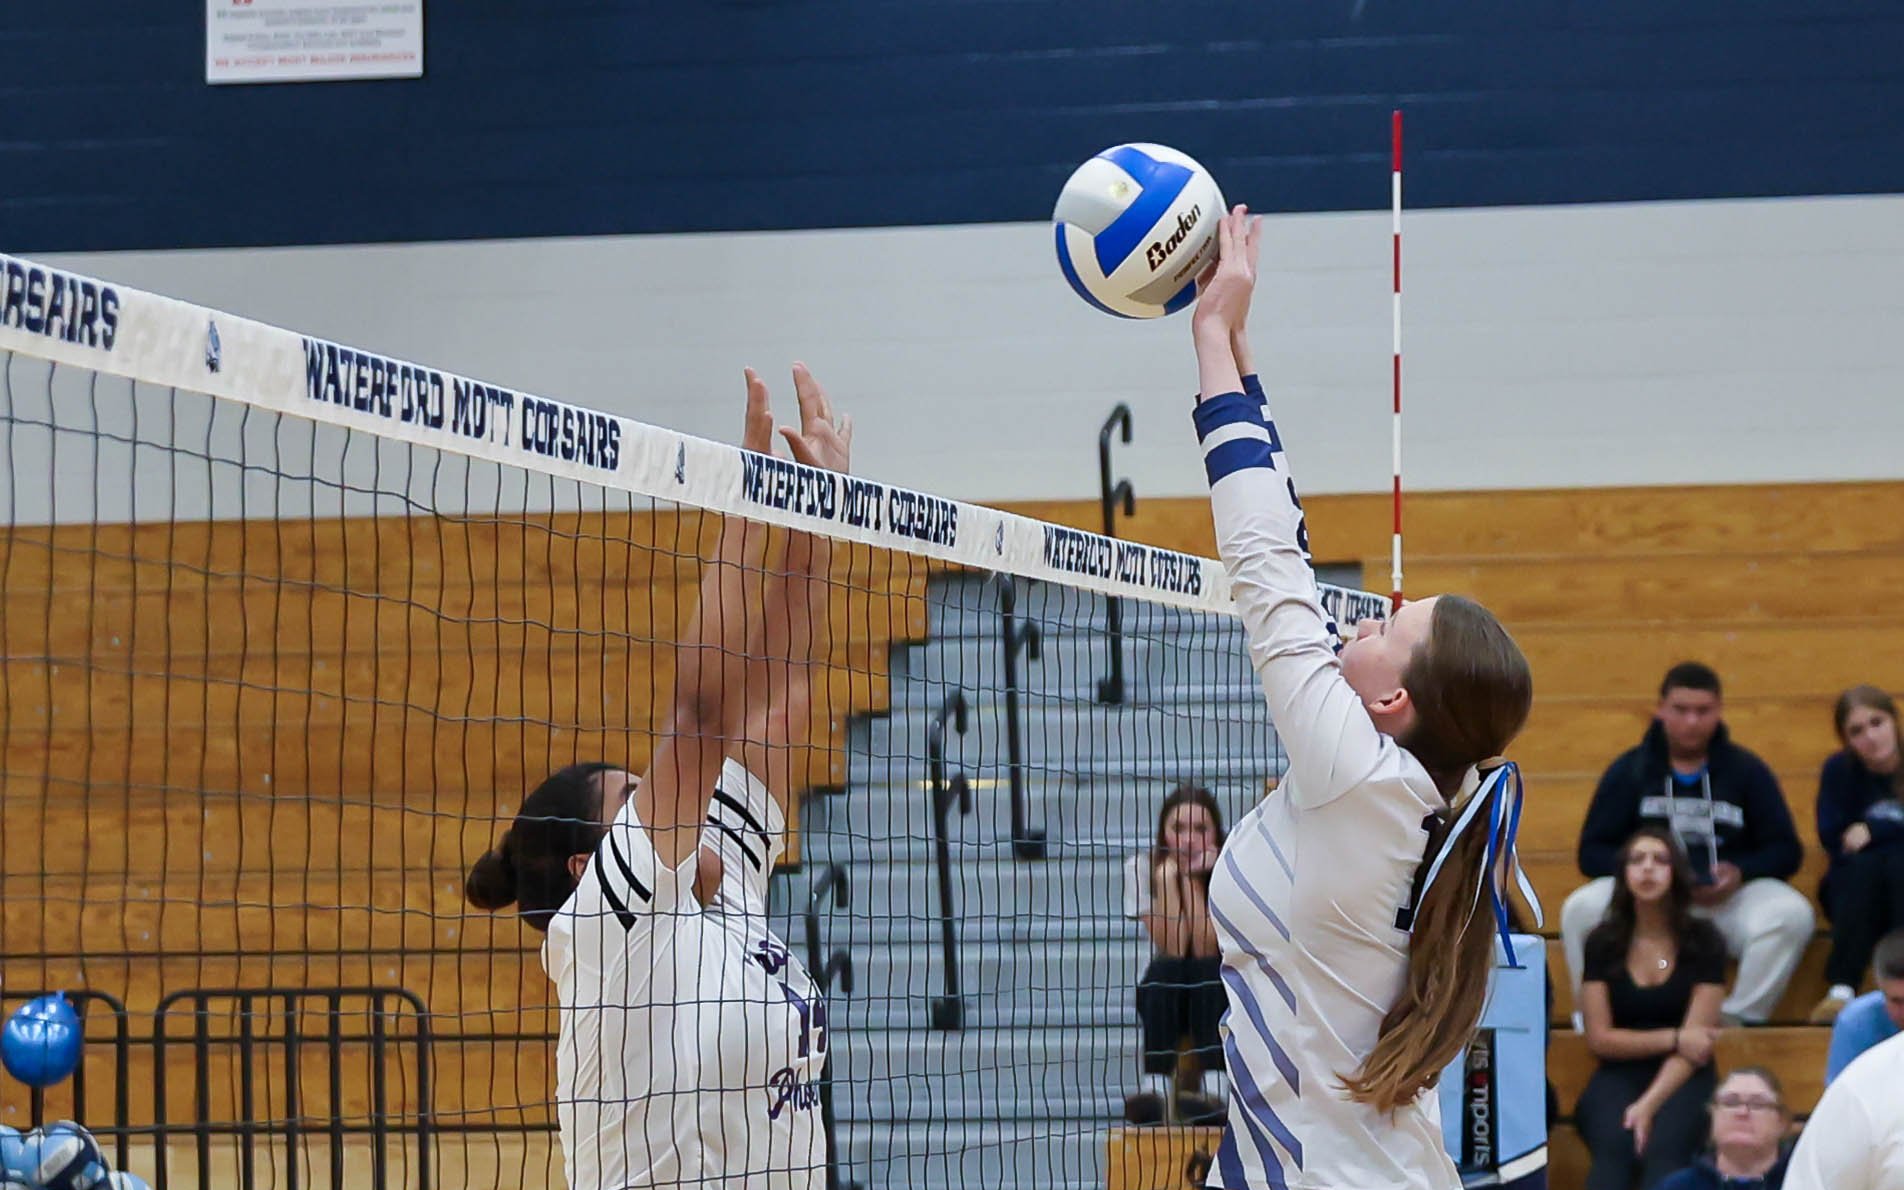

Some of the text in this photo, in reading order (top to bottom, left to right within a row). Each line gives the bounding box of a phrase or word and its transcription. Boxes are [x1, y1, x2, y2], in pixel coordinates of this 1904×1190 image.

[1146, 204, 1202, 272] Baden
[0, 260, 120, 352] RSAIRS
[302, 337, 621, 471] WATERFORD MOTT CORSAIRS
[739, 450, 958, 548] WATERFORD MOTT CORSAIRS
